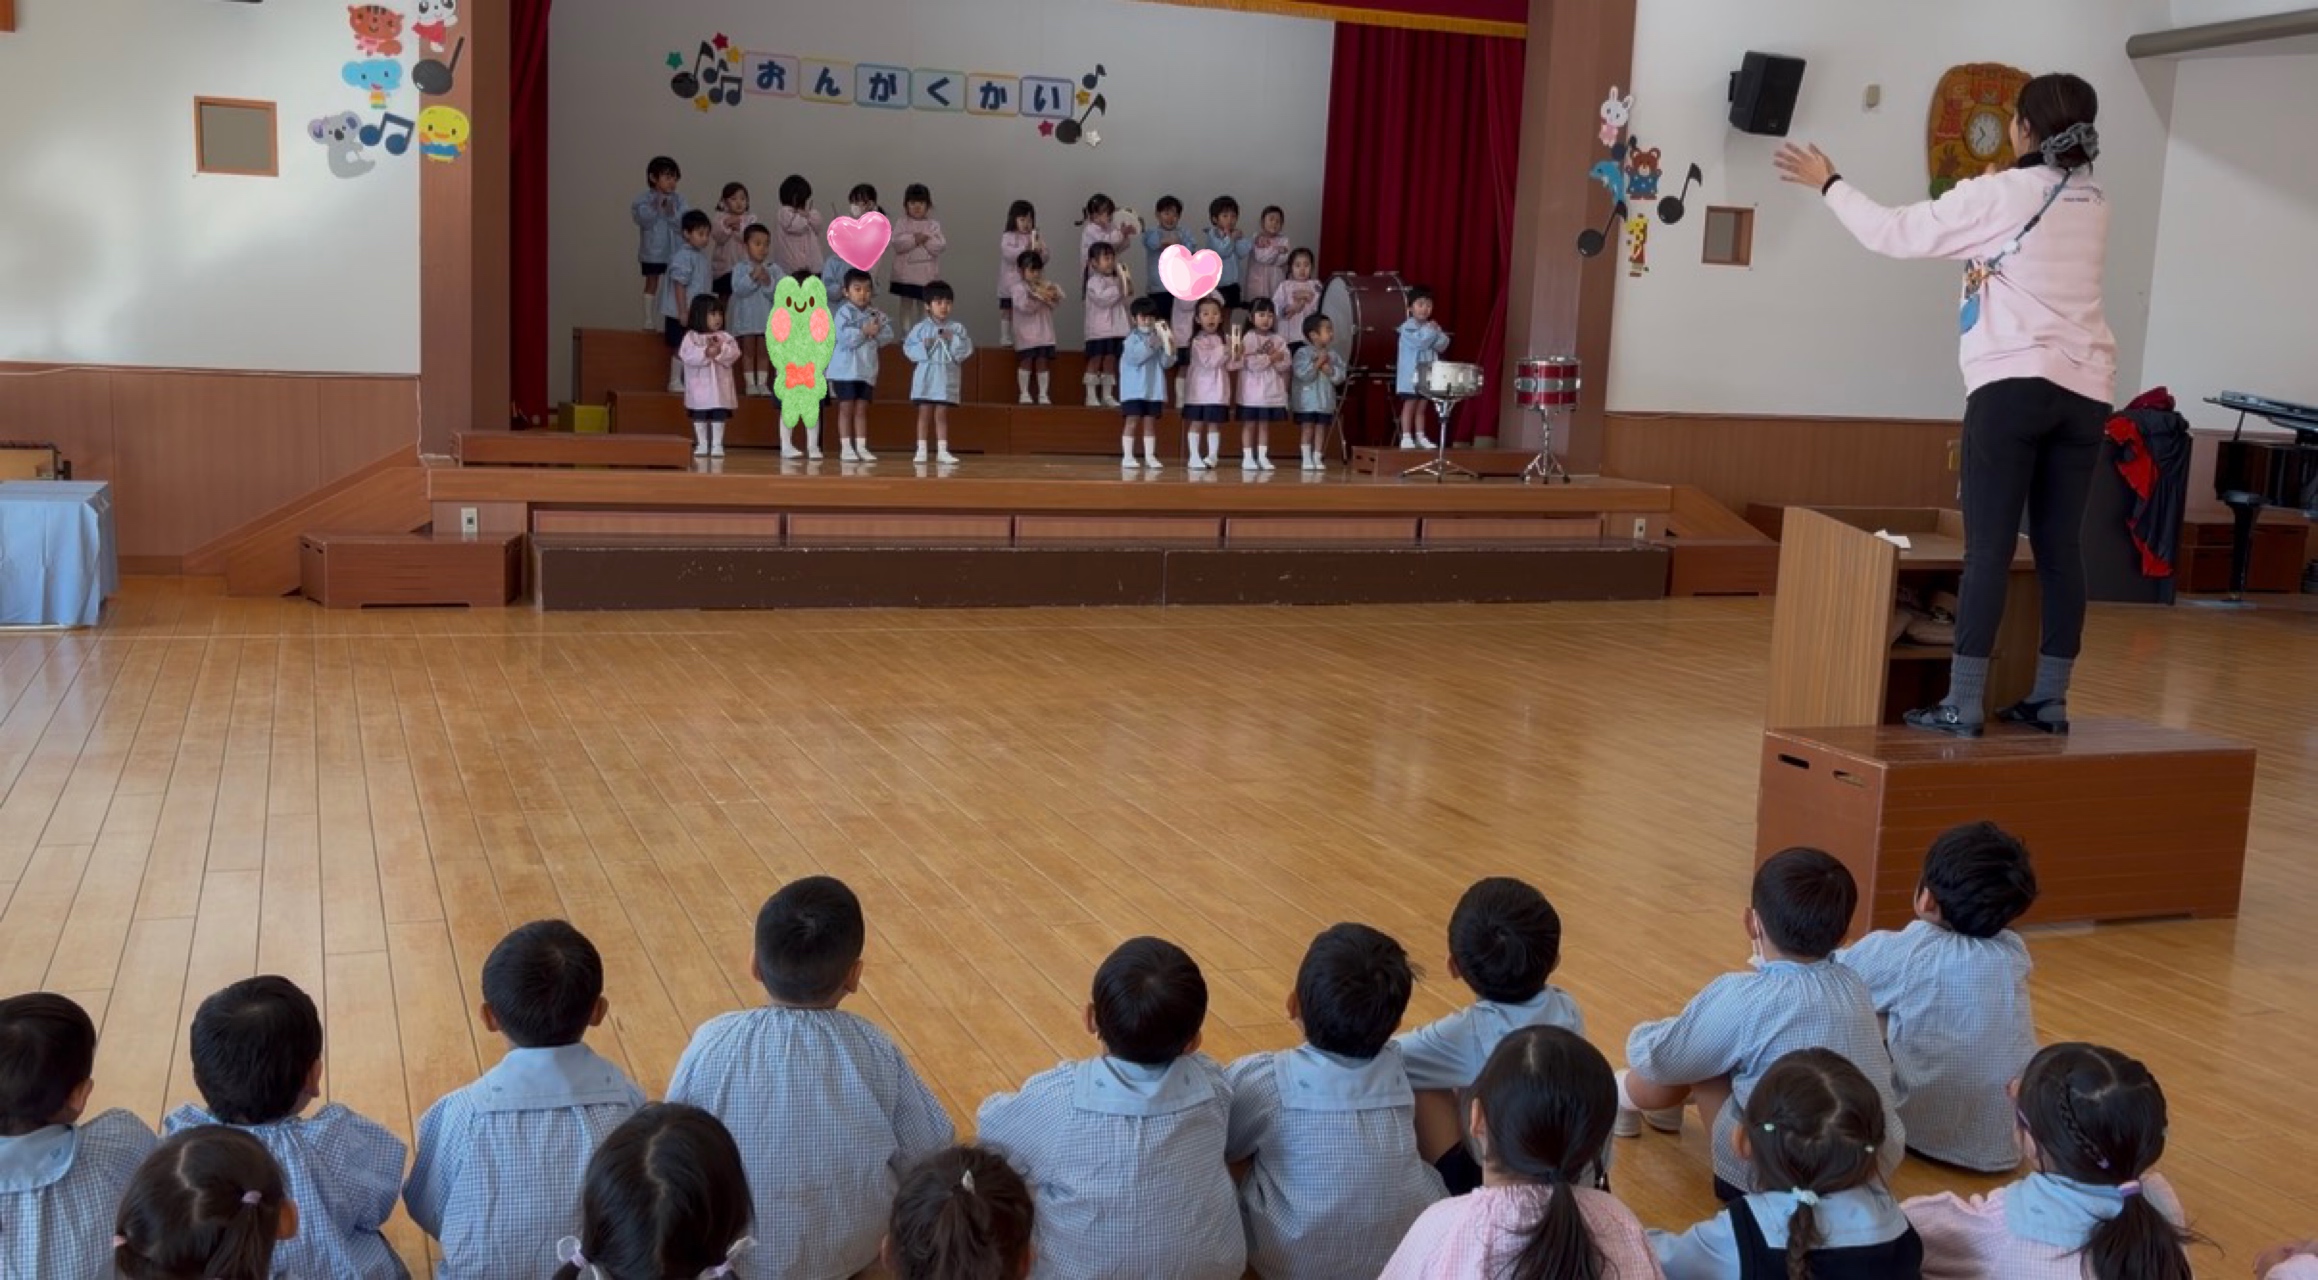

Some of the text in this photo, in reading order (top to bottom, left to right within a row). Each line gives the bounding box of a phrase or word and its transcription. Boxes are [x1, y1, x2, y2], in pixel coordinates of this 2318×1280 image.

[757, 60, 1060, 112] おんがくかい
